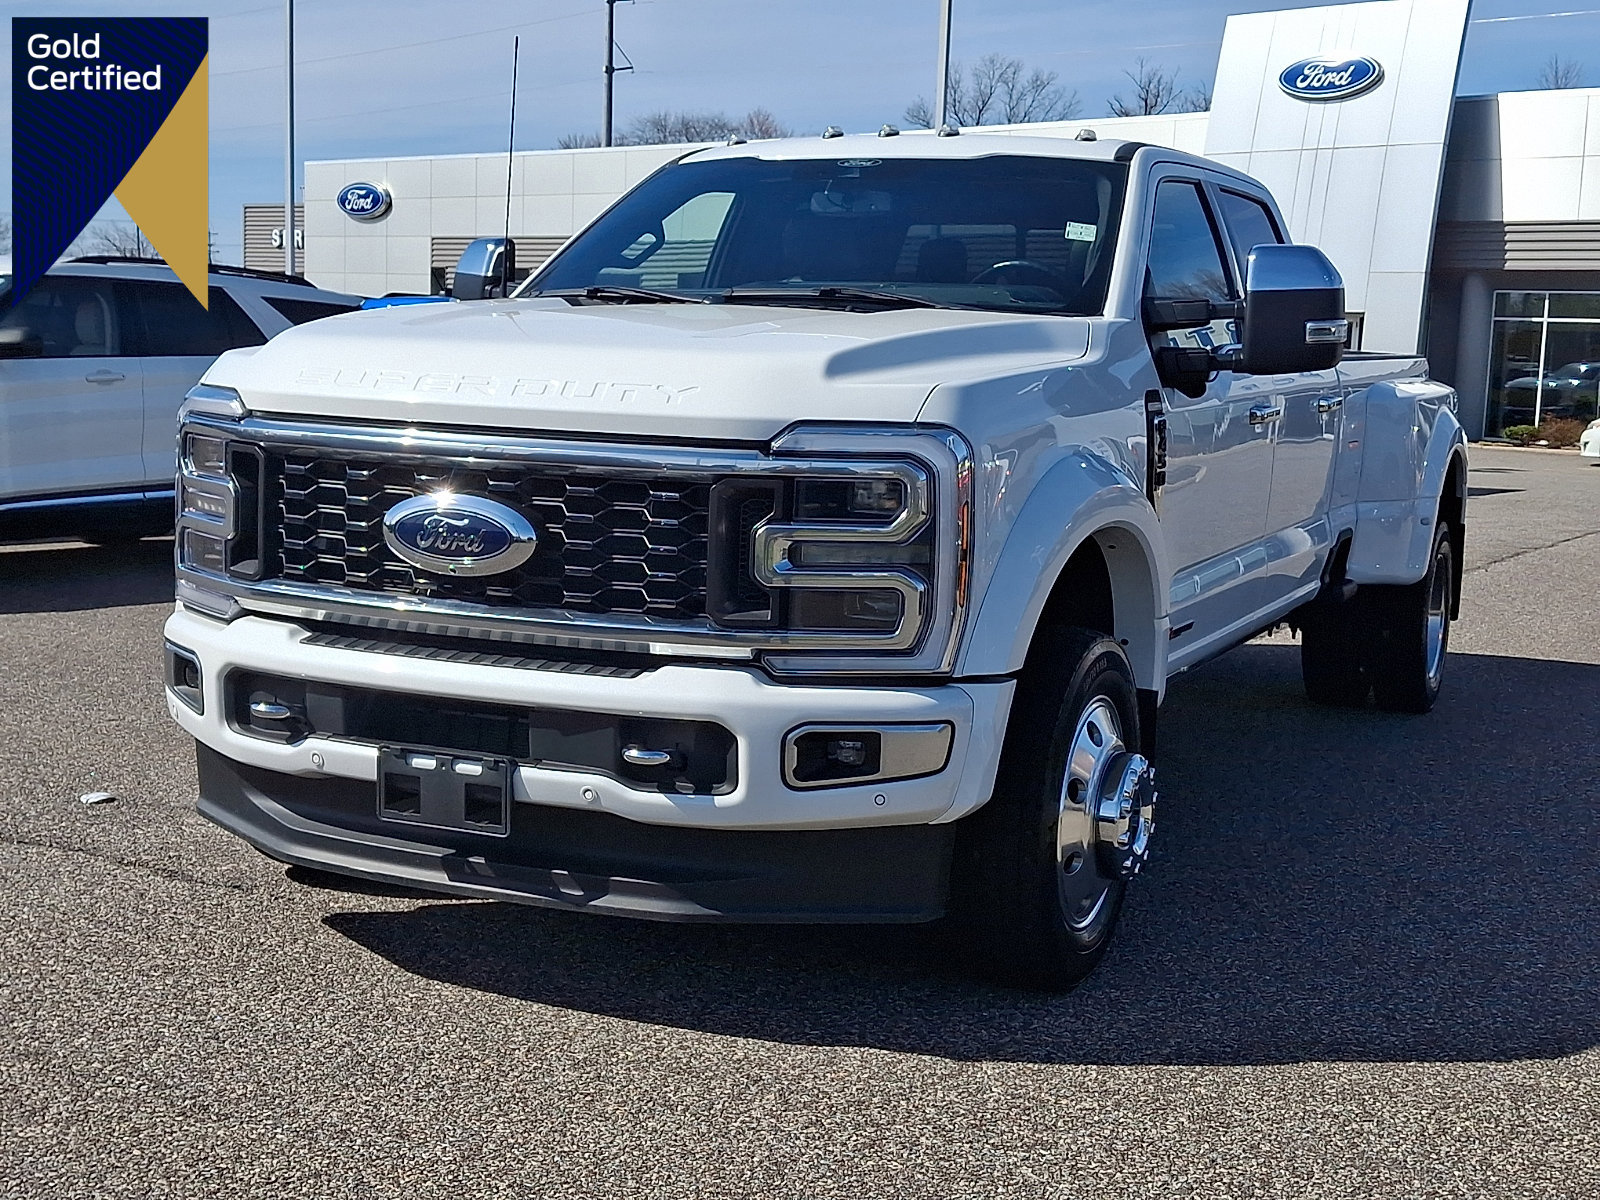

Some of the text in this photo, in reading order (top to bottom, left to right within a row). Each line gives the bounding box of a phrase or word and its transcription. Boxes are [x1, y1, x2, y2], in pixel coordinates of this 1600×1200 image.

[1296, 62, 1355, 88] Ford
[345, 189, 374, 210] Ford
[295, 368, 700, 404] SUPER DUTY
[416, 515, 486, 552] Ford
